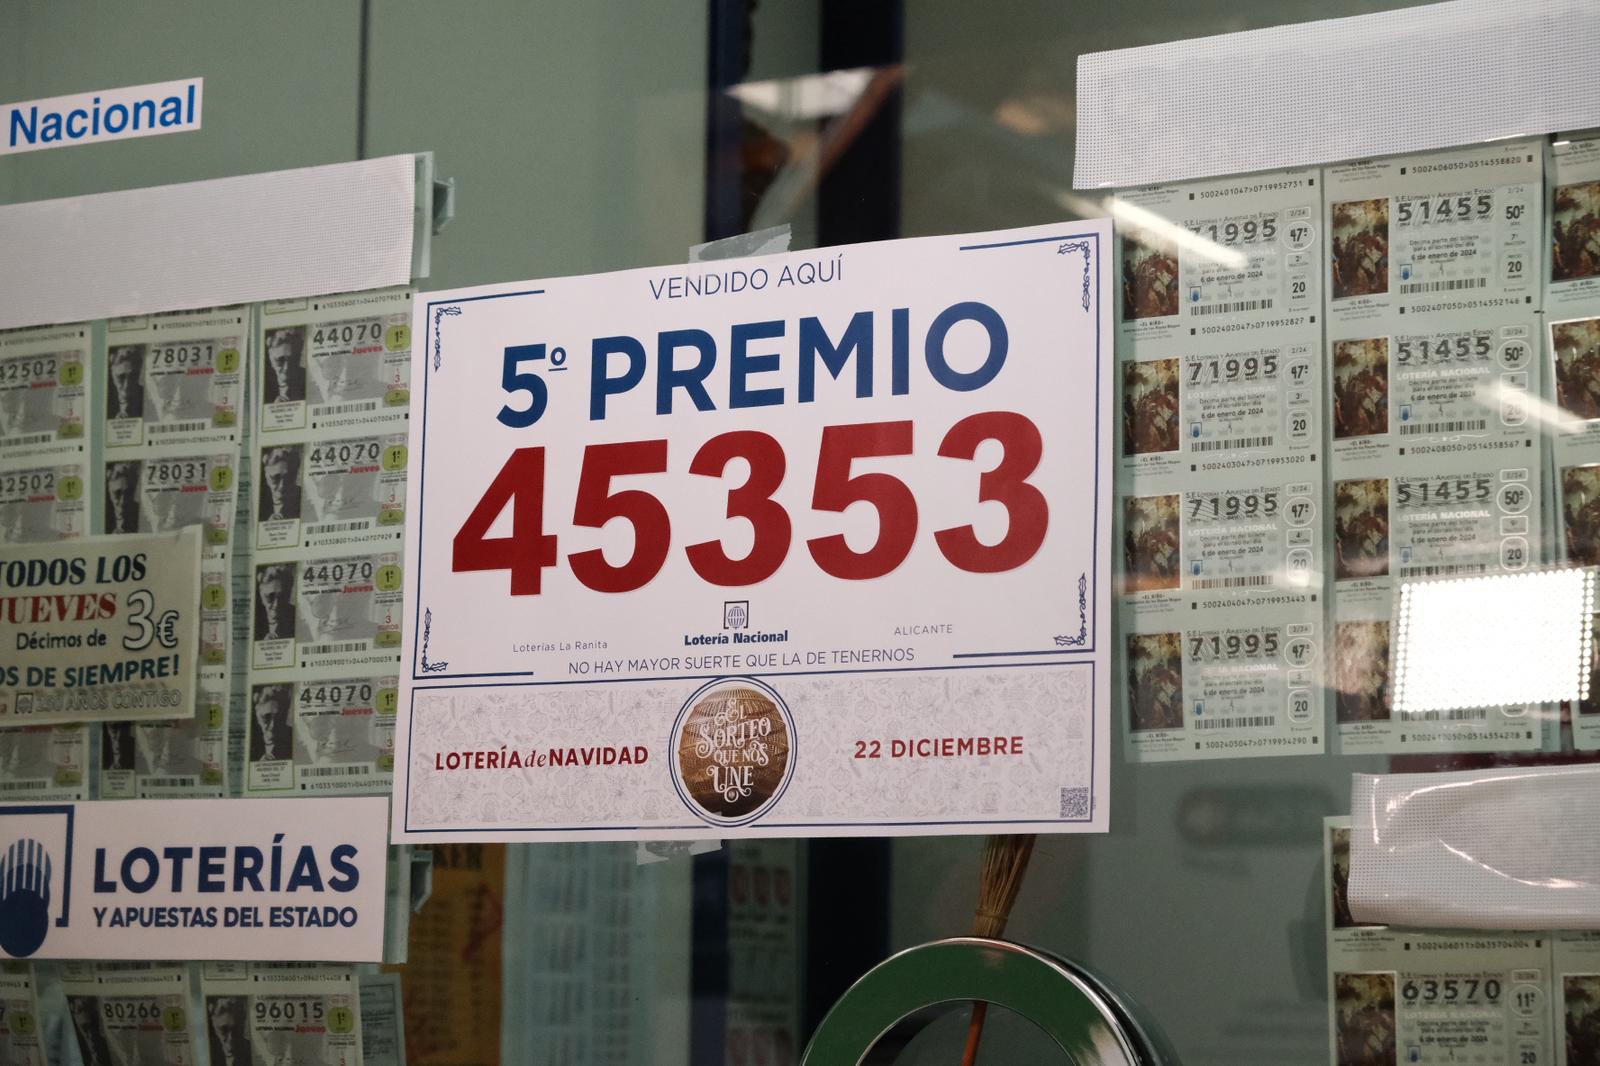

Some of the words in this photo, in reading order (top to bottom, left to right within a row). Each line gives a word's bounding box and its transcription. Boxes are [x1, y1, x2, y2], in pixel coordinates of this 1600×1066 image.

[10, 85, 195, 147] Nacional
[1200, 180, 1303, 199] 5002401047>0719952731
[1398, 195, 1491, 221] 51455
[1428, 251, 1448, 259] enero
[649, 268, 768, 300] VENDIDO
[778, 254, 844, 287] AQUÍ
[1247, 271, 1263, 279] 2024
[1507, 261, 1522, 273] 20
[1292, 282, 1306, 293] 20
[313, 323, 382, 345] 44070
[1201, 318, 1304, 334] 5002402047>0719952827
[152, 345, 213, 365] 78031
[352, 345, 383, 355] Jueves
[1398, 335, 1490, 361] 51455
[496, 343, 568, 428] 5º
[590, 301, 1009, 421] PREMIO
[1189, 355, 1277, 381] 71995
[1397, 368, 1438, 380] LOTERÍA
[1440, 367, 1490, 377] NACIONAL
[1217, 410, 1235, 418] enero
[1293, 420, 1306, 431] 20
[310, 443, 380, 463] 44070
[148, 462, 206, 482] 78031
[348, 465, 380, 474] Jueves
[0, 473, 54, 493] 2502
[1397, 479, 1490, 503] 51455
[452, 411, 1050, 597] 45353
[1189, 493, 1277, 518] 71995
[1440, 510, 1491, 520] NACIONAL
[1507, 548, 1522, 560] 20
[96, 553, 147, 584] LOS
[303, 562, 372, 582] 44070
[342, 585, 374, 594] Jueves
[122, 589, 180, 651] 3€
[894, 624, 953, 636] ALICANTE
[16, 631, 82, 650] Décimos
[87, 628, 107, 646] de
[513, 643, 556, 653] Loterías
[559, 642, 571, 652] La
[575, 640, 608, 651] Ranita
[684, 632, 729, 647] Lotería
[733, 630, 788, 645] Nacional
[1190, 633, 1278, 656] 71995
[26, 666, 57, 687] DE
[64, 654, 180, 689] SIEMPRE!
[568, 661, 590, 675] NO
[594, 660, 623, 675] HAY
[627, 658, 680, 672] MAYOR
[684, 655, 741, 670] SUERTE
[745, 654, 777, 668] QUE
[782, 654, 801, 667] LA
[806, 652, 827, 665] DE
[831, 648, 915, 664] TENERNOS
[301, 684, 372, 703] 44070
[341, 707, 374, 716] Jueves
[1294, 700, 1308, 712] 20
[695, 717, 772, 758] SORTEO
[854, 740, 881, 759] 22
[891, 736, 1023, 759] DICIEMBRE
[549, 746, 648, 767] NAVIDAD
[714, 749, 740, 767] QUE
[742, 740, 769, 766] NOS
[706, 765, 754, 802] UNE
[93, 833, 360, 893] LOTERÍAS
[93, 907, 109, 928] Y
[110, 907, 218, 928] APUESTAS
[224, 907, 264, 928] DEL
[269, 906, 358, 928] ESTADO
[1402, 979, 1501, 1000] 63570
[104, 1003, 160, 1018] 80266
[256, 1002, 323, 1019] 96015
[294, 1024, 326, 1034] Jueves
[1521, 1052, 1536, 1064] 20
